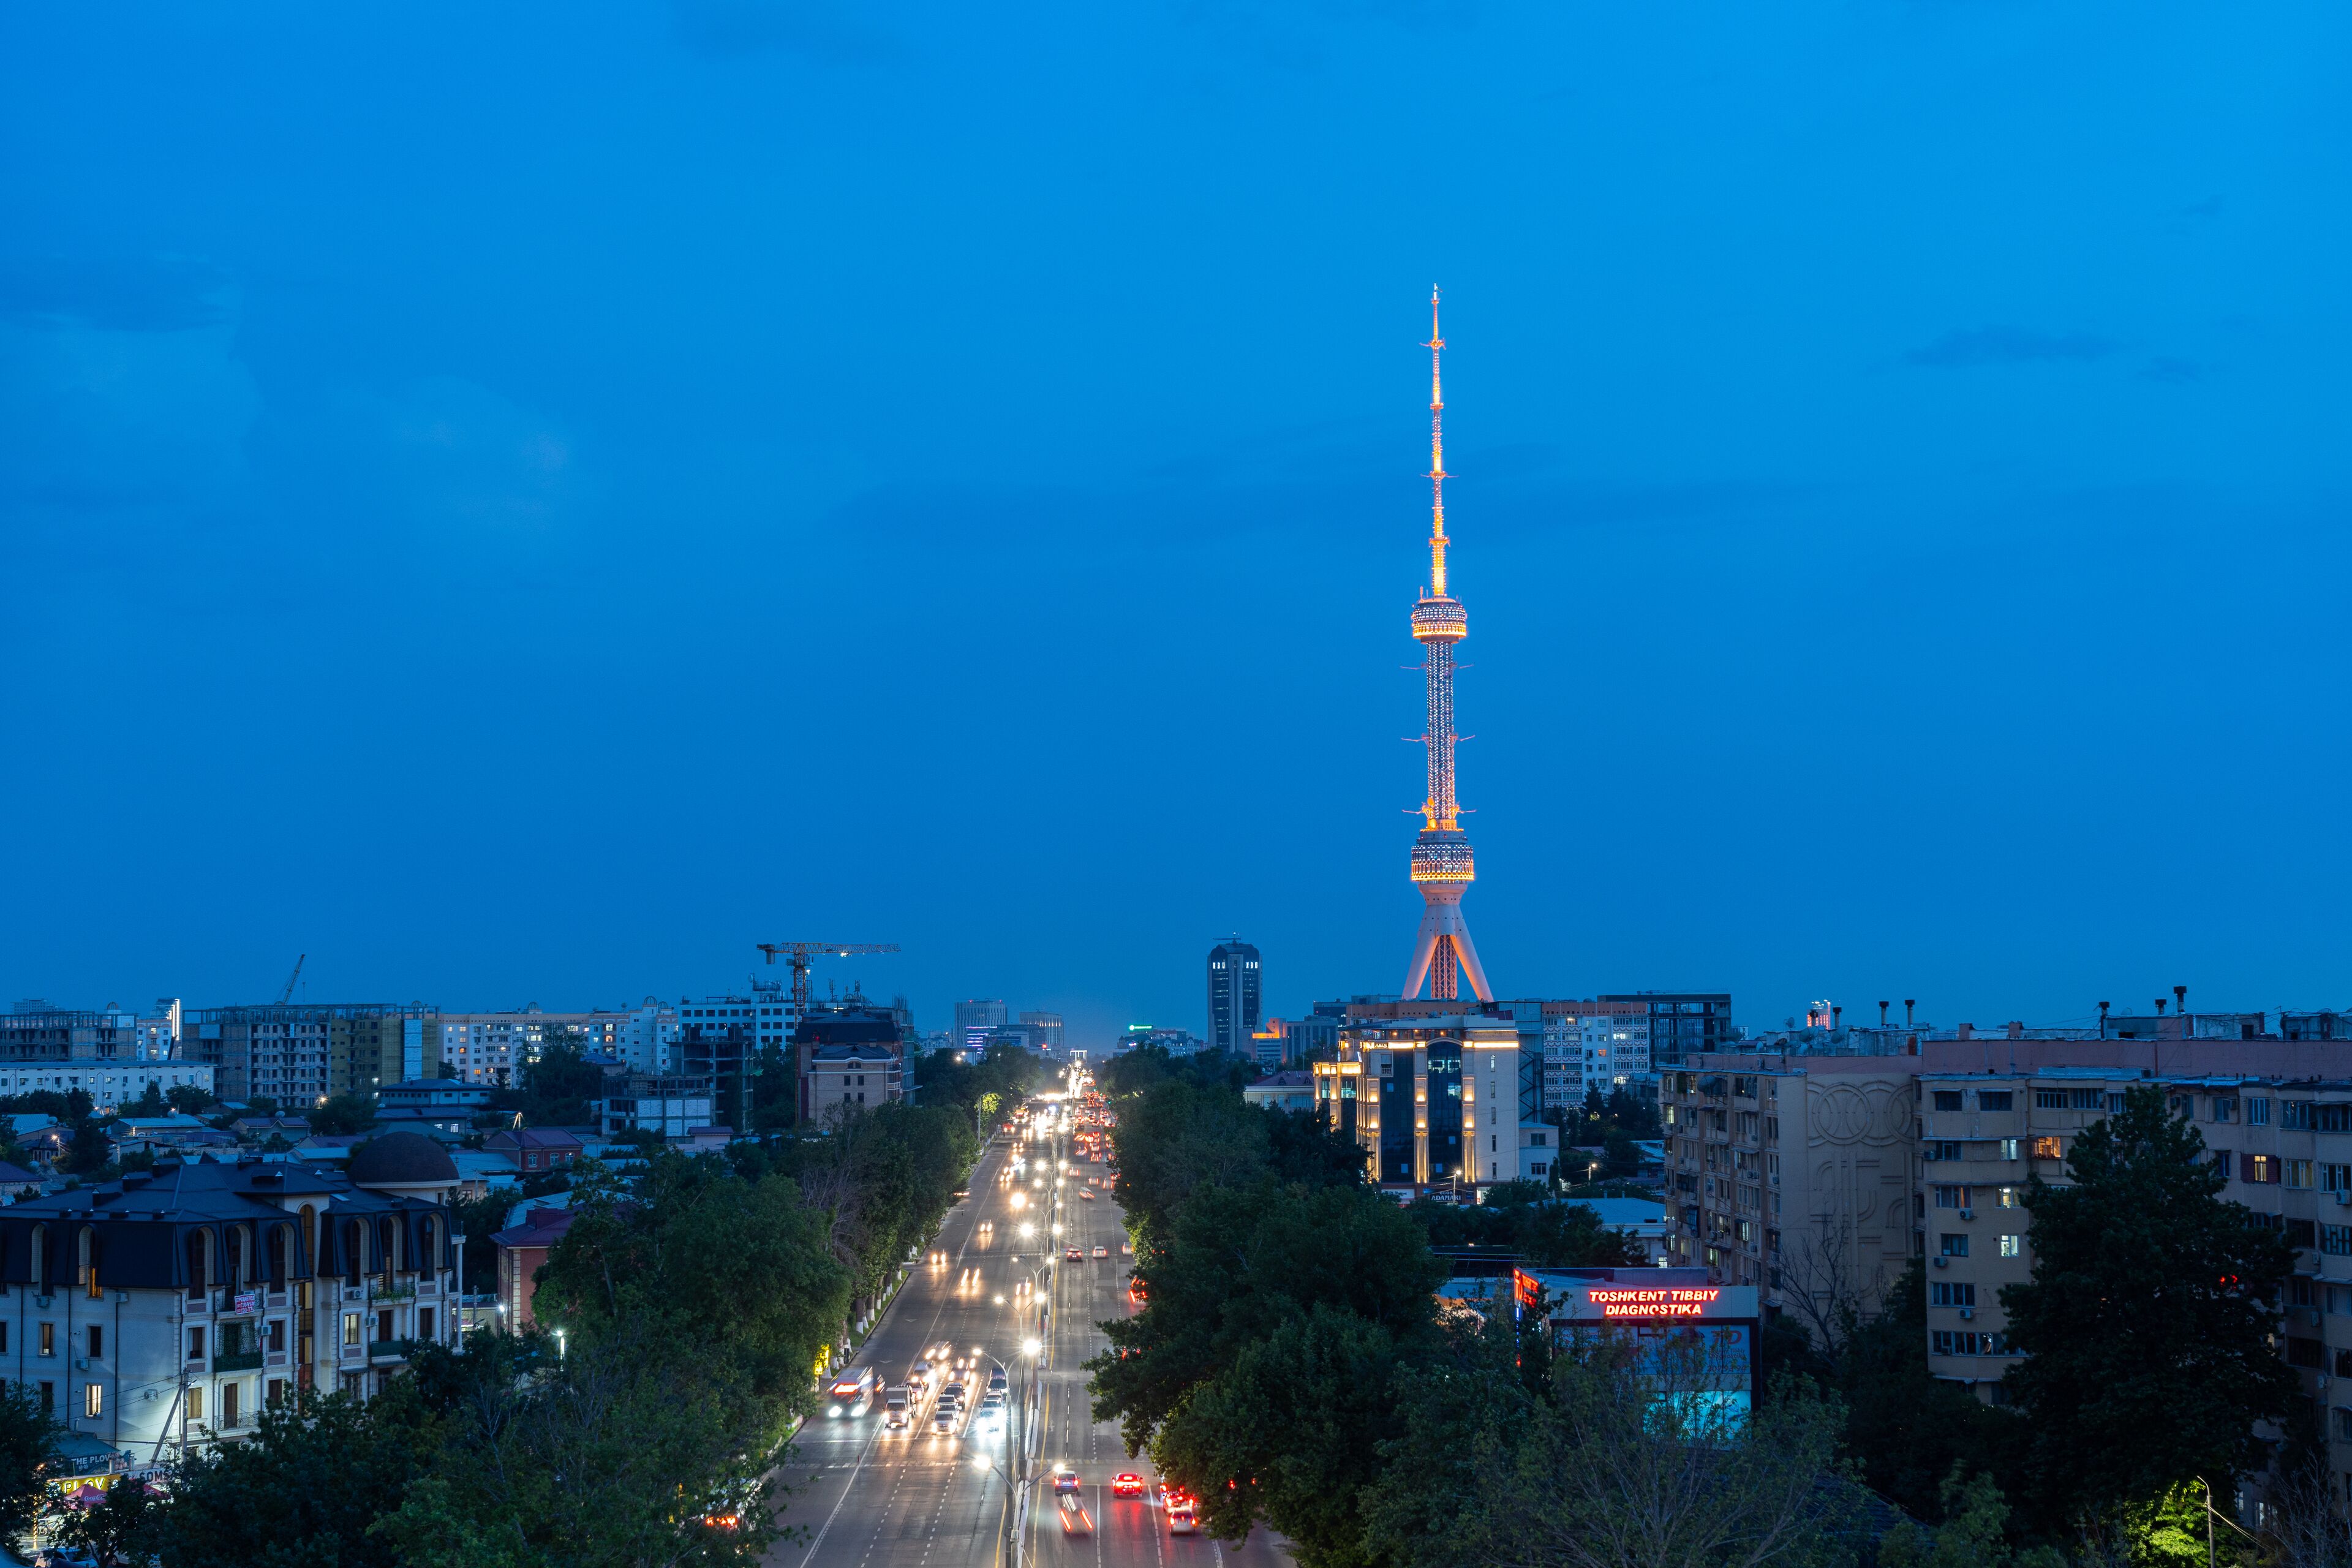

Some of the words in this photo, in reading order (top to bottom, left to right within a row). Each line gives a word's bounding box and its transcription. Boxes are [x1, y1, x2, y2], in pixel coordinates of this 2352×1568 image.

[1589, 1291, 1667, 1302] TOSHKENT
[1671, 1290, 1719, 1301] TIBBIY
[1605, 1303, 1702, 1315] DIAGNOSTIKA
[90, 1455, 110, 1463] PLOV
[140, 1470, 172, 1482] SOMS
